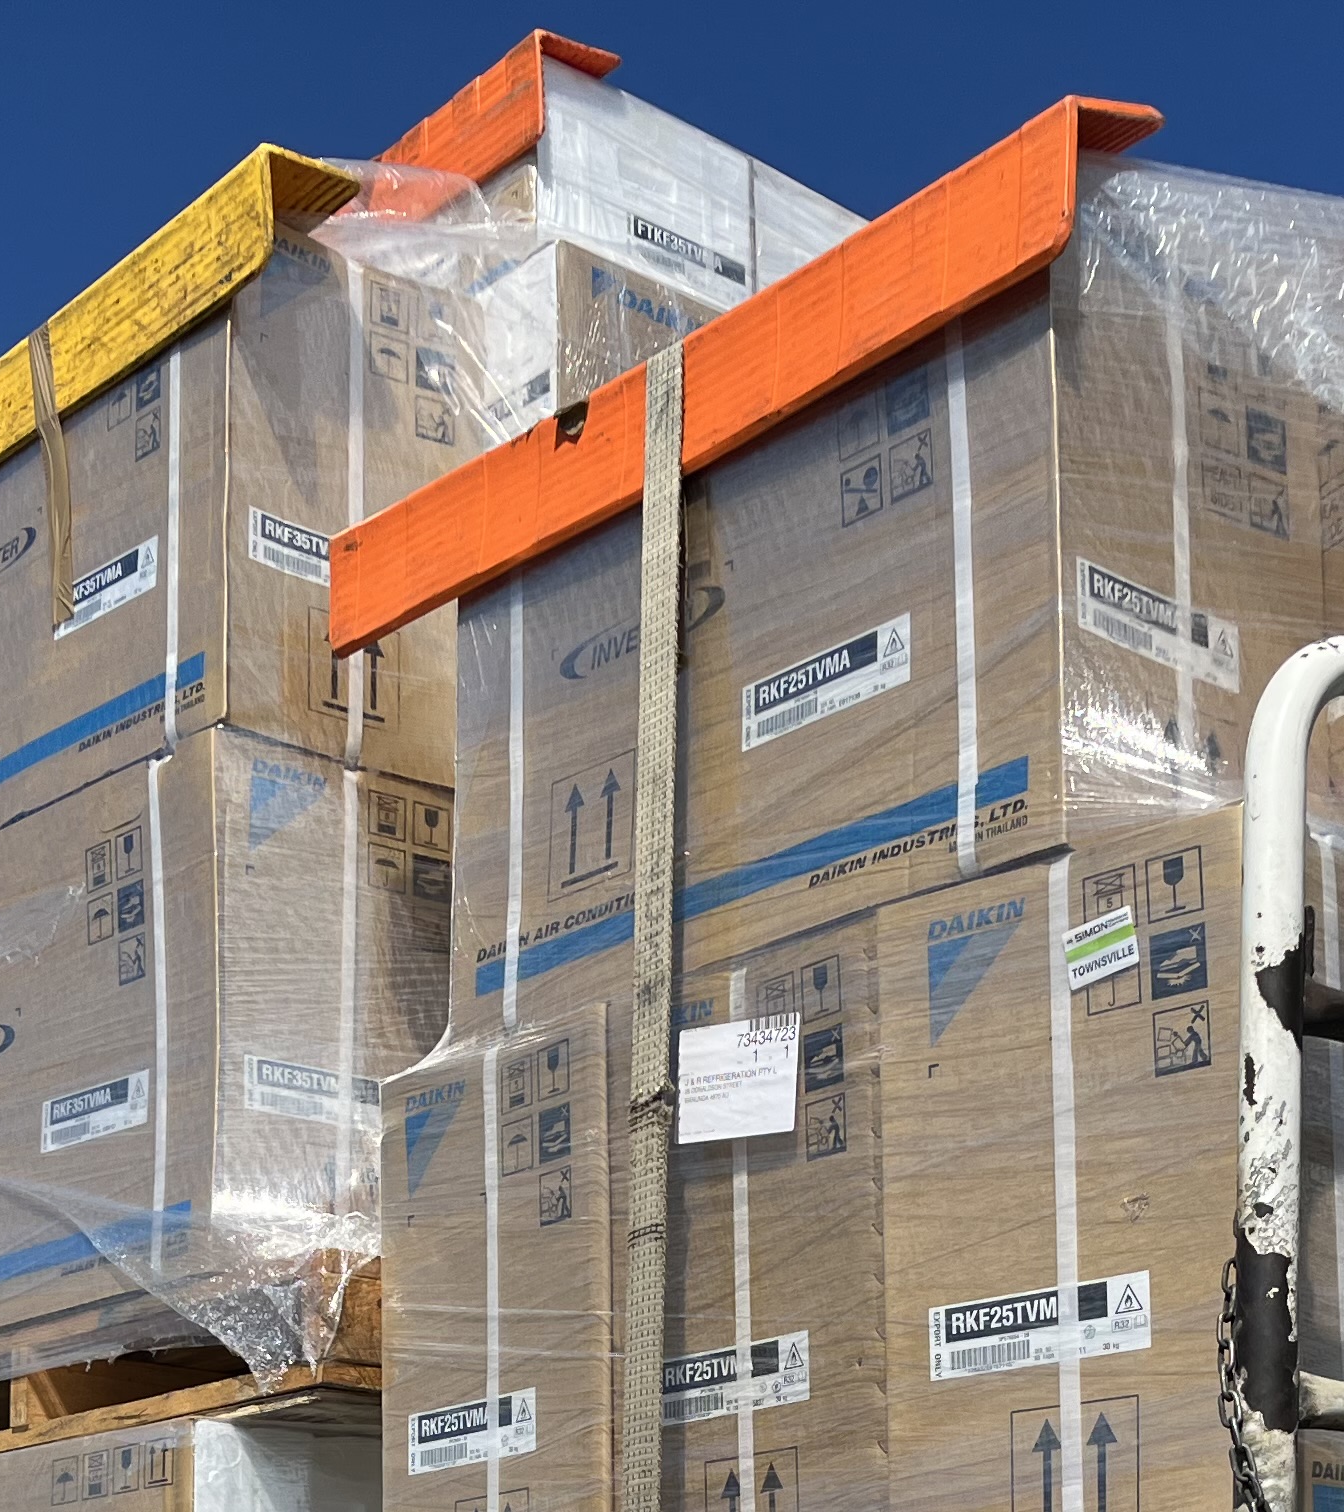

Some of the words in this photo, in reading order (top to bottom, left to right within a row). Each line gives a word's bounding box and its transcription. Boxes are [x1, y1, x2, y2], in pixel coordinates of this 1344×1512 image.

[273, 237, 331, 274] AIKIN
[636, 218, 724, 272] FTKF35TVA
[264, 519, 329, 556] RKF35TV
[72, 562, 123, 602] KF35TVMA
[759, 649, 851, 706] RKF25TVMA
[78, 727, 113, 753] DAIKIN
[182, 681, 206, 701] LTD.
[252, 758, 328, 789] DAIKIN
[808, 855, 868, 889] DAIKIN
[871, 815, 985, 866] INDUSTRIS,
[988, 798, 1029, 822] LTD.
[985, 815, 1029, 838] THAILAND
[533, 920, 560, 943] AIR
[928, 897, 1027, 941] DAIKIN
[1074, 921, 1108, 943] SIMON
[1072, 943, 1135, 979] TOWNSVILLE
[737, 1026, 796, 1048] 73434723
[703, 1069, 756, 1084] REFRIGERATION
[52, 1087, 113, 1121] RKF35TVMA
[405, 1078, 467, 1113] DAIKIN
[933, 1311, 942, 1348] EXPORT
[951, 1296, 1058, 1335] RKF25TVM
[1114, 1319, 1130, 1331] R32
[934, 1353, 942, 1378] ONLY
